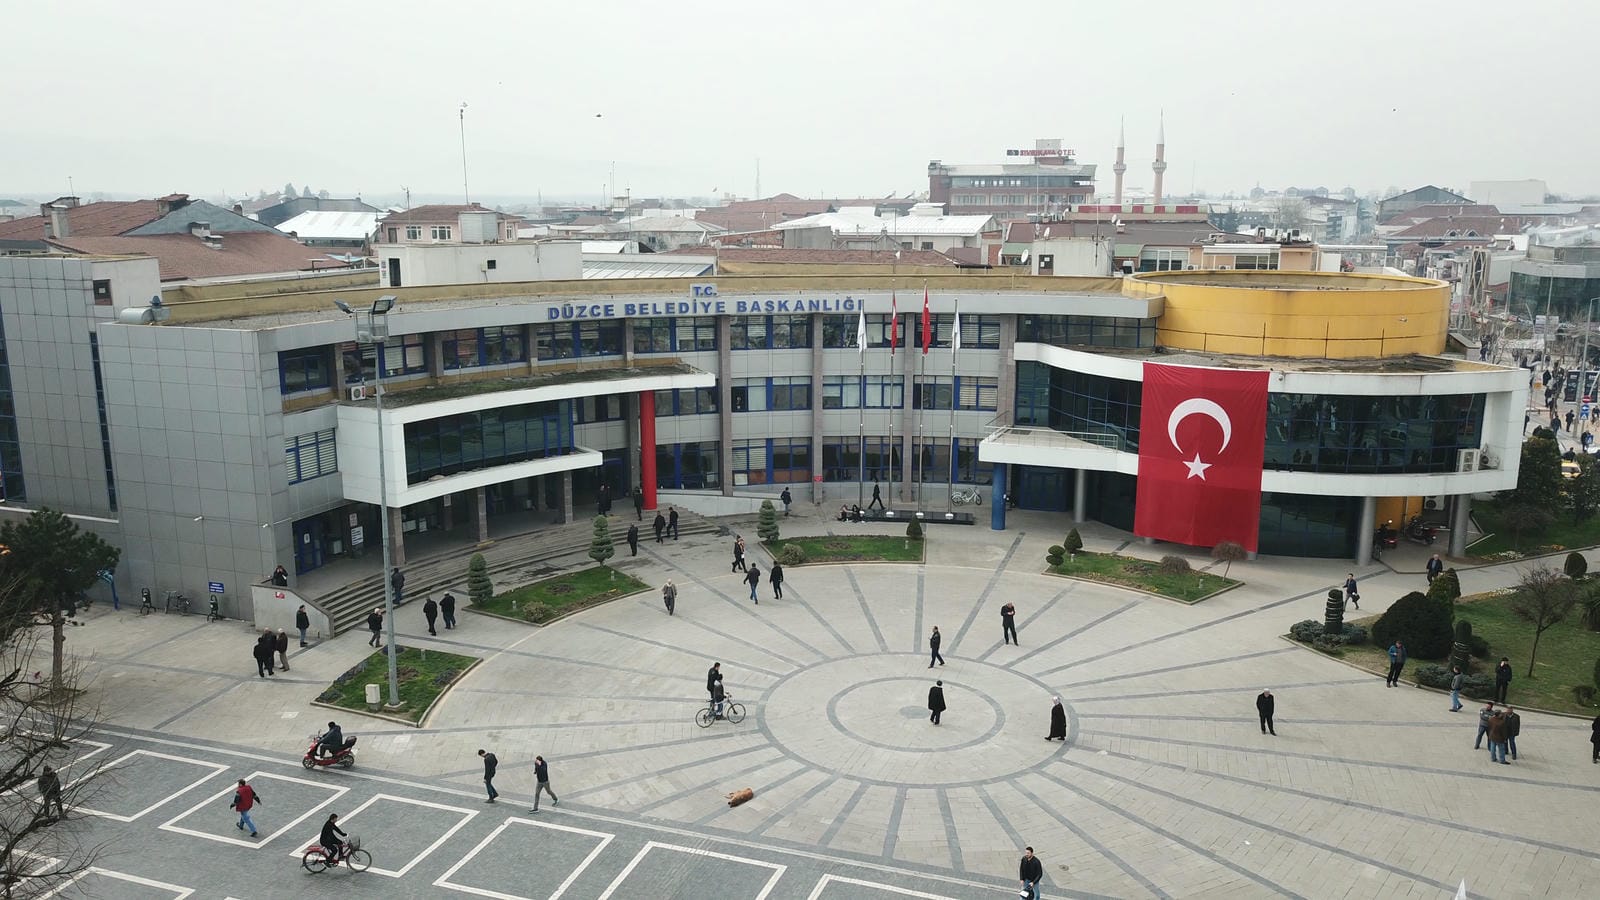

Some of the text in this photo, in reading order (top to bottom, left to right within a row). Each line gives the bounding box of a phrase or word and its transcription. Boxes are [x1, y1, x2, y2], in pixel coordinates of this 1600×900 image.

[693, 286, 718, 297] T.C.
[547, 296, 864, 321] DÜZCE BELEDİYE BAŞKANLIĞI
